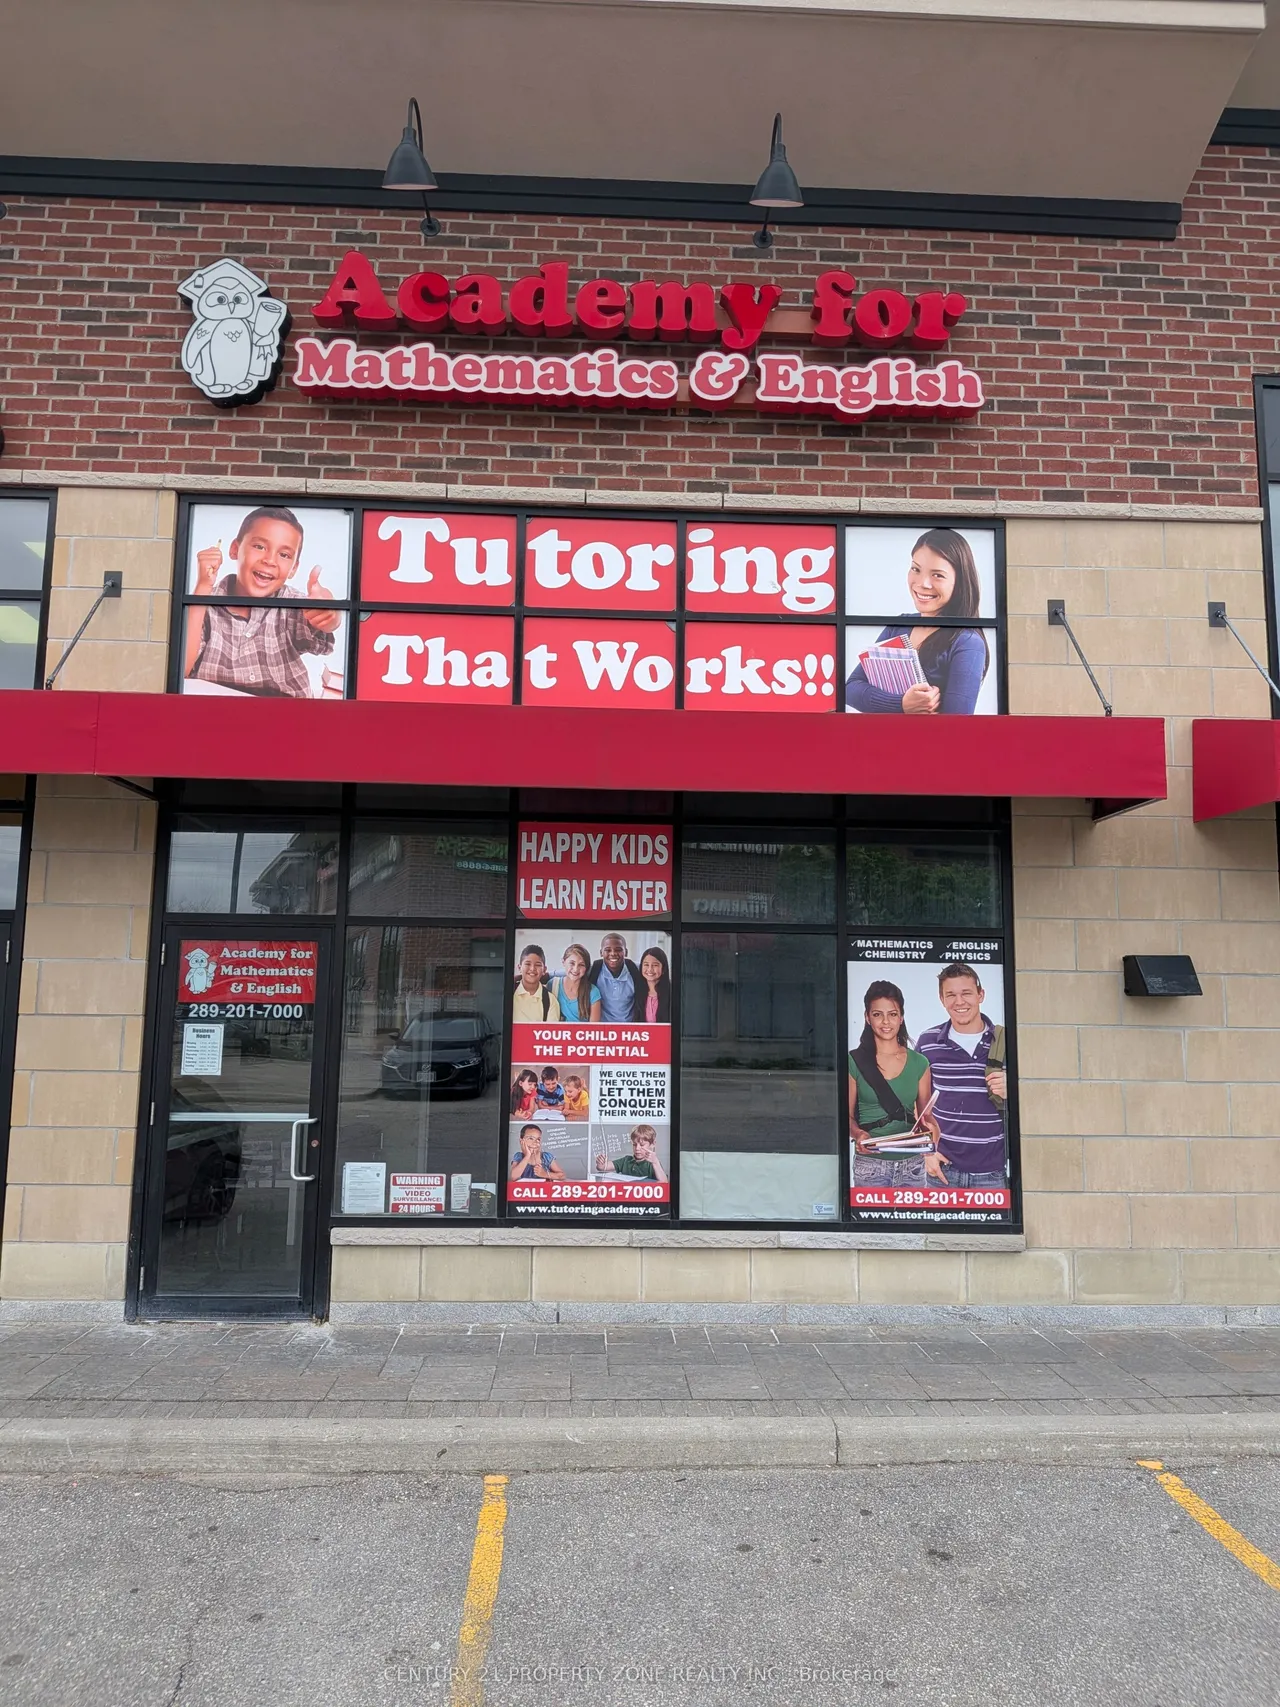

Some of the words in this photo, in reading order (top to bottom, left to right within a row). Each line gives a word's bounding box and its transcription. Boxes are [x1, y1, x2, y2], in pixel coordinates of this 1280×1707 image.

[311, 250, 782, 352] Academy
[811, 269, 968, 348] for
[295, 338, 678, 399] Mathematics
[689, 352, 750, 401] &
[756, 354, 986, 413] English
[377, 516, 836, 612] Tutoring
[373, 634, 558, 690] That
[572, 640, 835, 697] Works!!
[520, 831, 604, 864] HAPPY
[610, 834, 669, 866] KIDS
[518, 878, 587, 911] LEARN
[591, 879, 669, 912] FASTER
[856, 940, 934, 949] MATHEMATICS
[952, 942, 999, 951] ENGLISH
[220, 947, 287, 960] Academy
[290, 948, 313, 959] for
[864, 950, 926, 960] CHEMISTRY
[945, 952, 991, 960] PHYSICS
[220, 965, 314, 977] Mathematics
[230, 982, 243, 994] &
[246, 982, 302, 996] English
[188, 1003, 303, 1018] 289-201-7000
[533, 1030, 572, 1041] YOUR
[575, 1030, 618, 1042] CHILD
[621, 1031, 650, 1042] HAS
[533, 1045, 563, 1056] THE
[567, 1045, 649, 1057] POTENTIAL
[599, 1070, 613, 1078] WE
[616, 1070, 638, 1078] GIVE
[640, 1071, 666, 1079] THEM
[599, 1079, 618, 1087] THE
[620, 1079, 651, 1087] TOOLS
[653, 1079, 666, 1087] TO
[599, 1087, 624, 1097] LET
[628, 1087, 666, 1098] THEM
[598, 1098, 666, 1109] CONQUER
[598, 1109, 627, 1117] THEIR
[395, 1176, 441, 1185] WARNING
[513, 1187, 548, 1198] CALL
[551, 1184, 664, 1199] 289-201-7000
[855, 1193, 890, 1204] CALL
[894, 1191, 1005, 1205] 289-201-7000
[398, 1204, 408, 1213] 24
[410, 1204, 436, 1213] HOURS
[516, 1204, 661, 1216] www.tutoringacademy.ca
[859, 1210, 1002, 1222] www.tutoringacademy.ca
